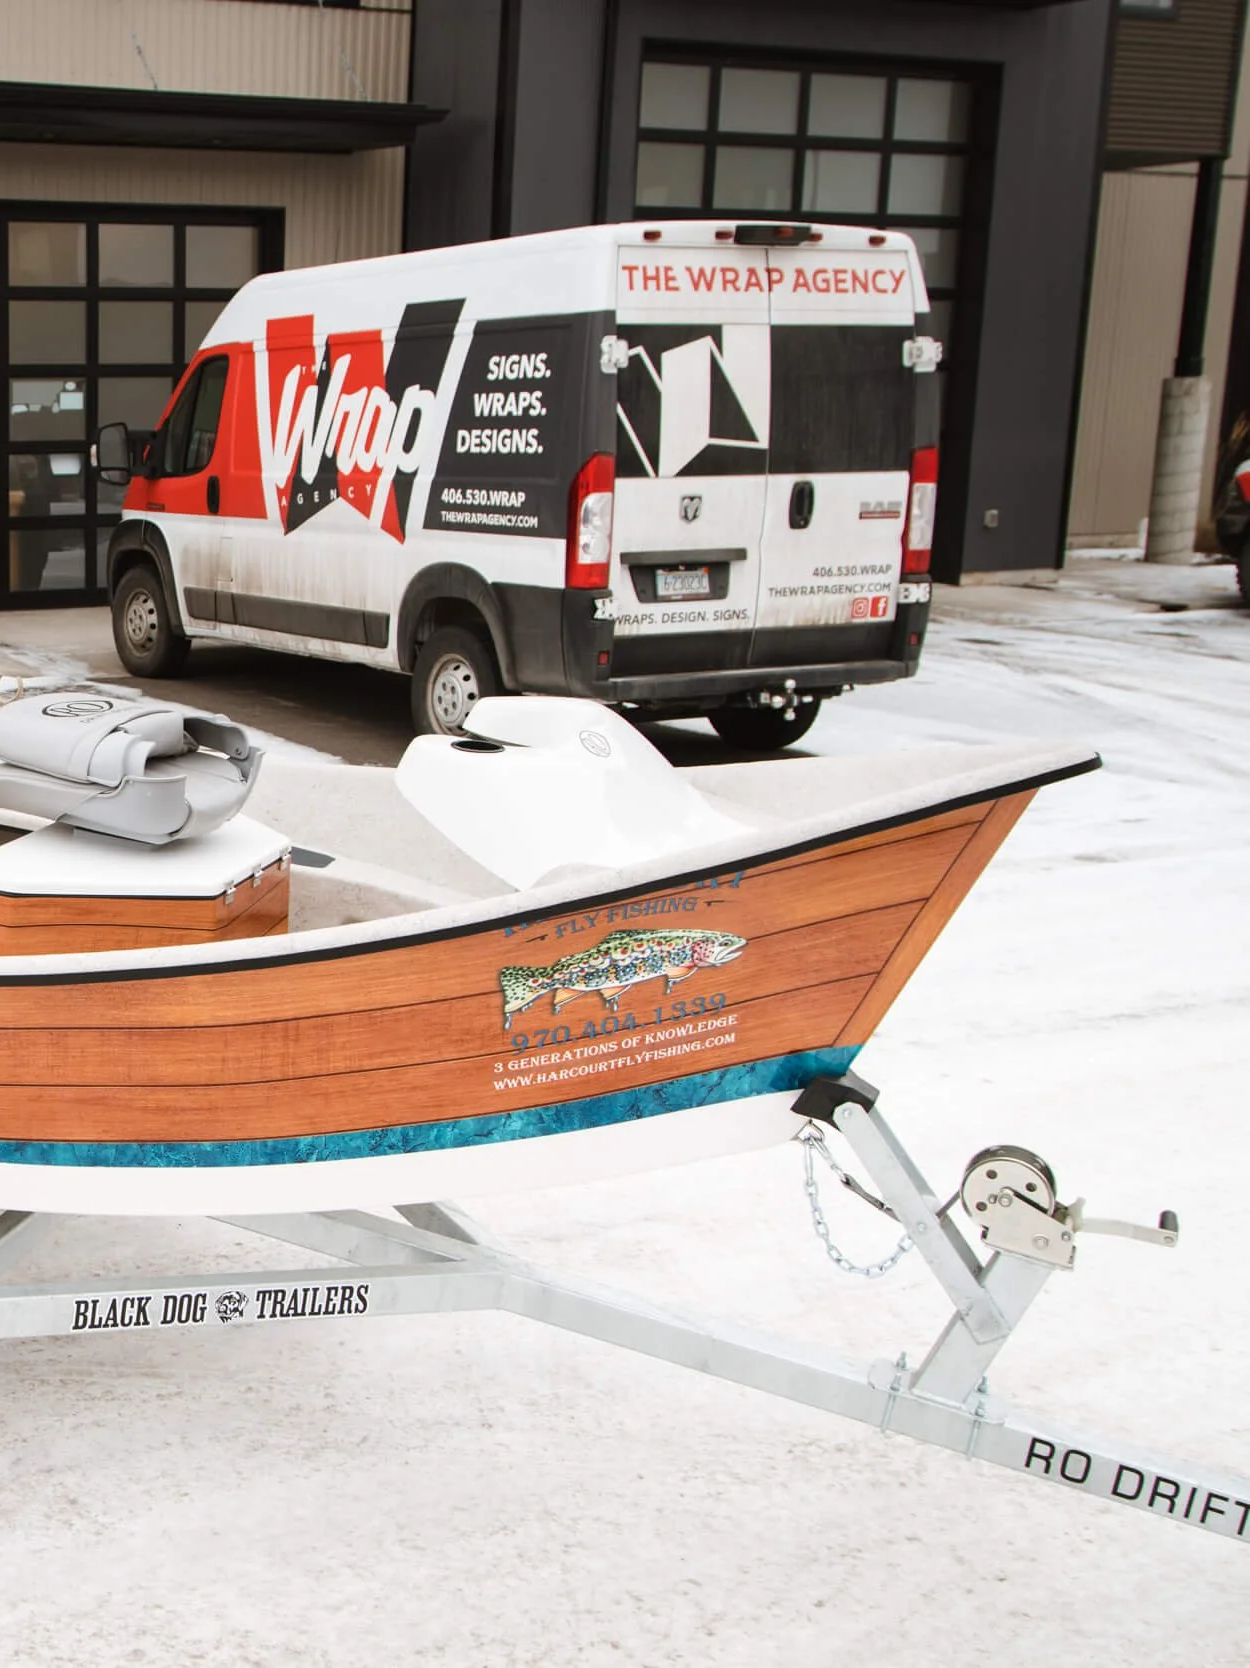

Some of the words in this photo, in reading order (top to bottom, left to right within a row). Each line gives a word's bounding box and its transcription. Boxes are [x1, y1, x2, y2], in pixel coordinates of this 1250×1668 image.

[621, 265, 680, 291] THE
[685, 266, 784, 293] WRAP
[792, 268, 906, 294] AGENCY
[487, 352, 551, 380] SIGNS.
[473, 390, 547, 417] WRAPS.
[273, 353, 438, 522] Wrap
[456, 428, 543, 454] DESIGNS.
[281, 484, 373, 508] AGENCY
[441, 488, 526, 507] 406.530.WRAP
[440, 510, 538, 528] THEWRAPAGENCY.COM
[812, 564, 893, 577] 406.530.WRAP
[768, 582, 891, 598] THEWRAPAGENCY.COM
[661, 611, 710, 624] DESIGN.
[713, 609, 750, 621] SIGNS.
[555, 911, 602, 939] FLY
[607, 896, 699, 923] FISHING
[510, 992, 727, 1057] 970.404.1339
[493, 1062, 504, 1073] 3
[508, 1042, 619, 1071] GENERATIONS
[621, 1036, 642, 1049] OF
[645, 1014, 739, 1043] KNOWLEDGE
[493, 1032, 737, 1091] WWW.HARCOURTFLYFISHING.COM
[71, 1295, 153, 1331] BLACK
[160, 1292, 208, 1325] DOG
[255, 1284, 370, 1320] TRAILERS
[1024, 1436, 1092, 1485] RO
[1110, 1463, 1250, 1537] DRIFT
